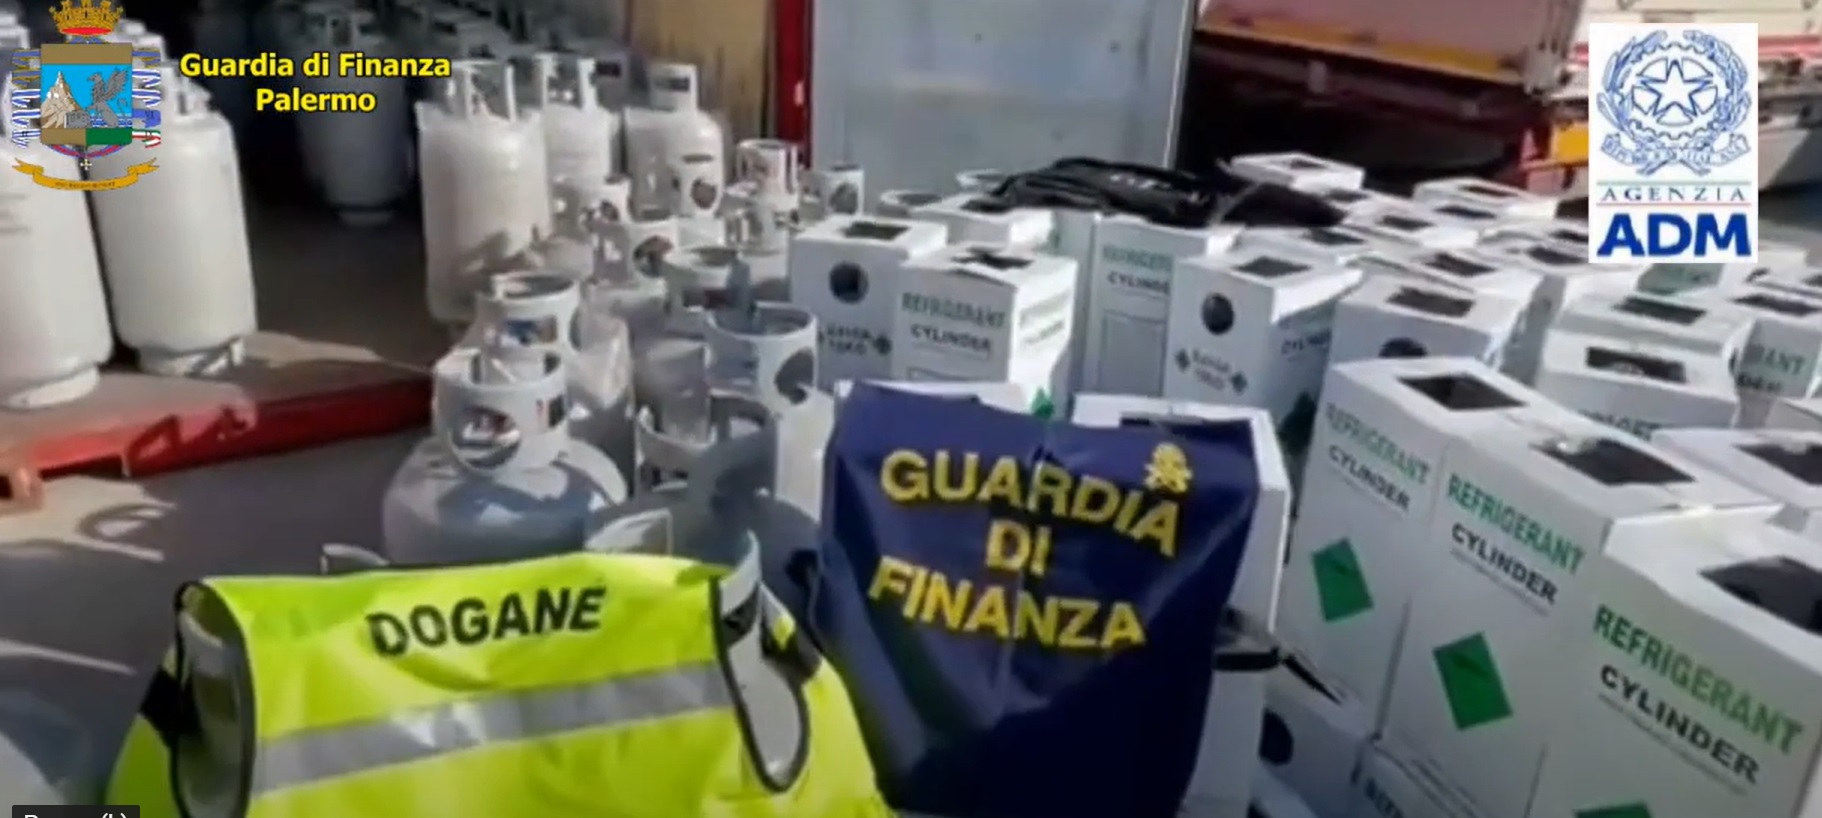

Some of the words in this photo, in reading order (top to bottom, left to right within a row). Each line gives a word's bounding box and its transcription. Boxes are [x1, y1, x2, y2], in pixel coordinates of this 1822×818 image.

[910, 323, 991, 350] CYLINDER
[1326, 402, 1430, 486] REFRIGERANT
[1329, 444, 1410, 512] CYLINDER
[880, 449, 1180, 557] GUARDIA
[1449, 473, 1585, 576] REFRIGERANT
[985, 519, 1052, 576] DI
[1453, 522, 1558, 604] CYLINDER
[366, 586, 607, 658] DOGANE
[868, 556, 1147, 649] FINANZA
[1593, 604, 1803, 755] REFRIGERANT
[1601, 664, 1760, 785] CYLINDER
